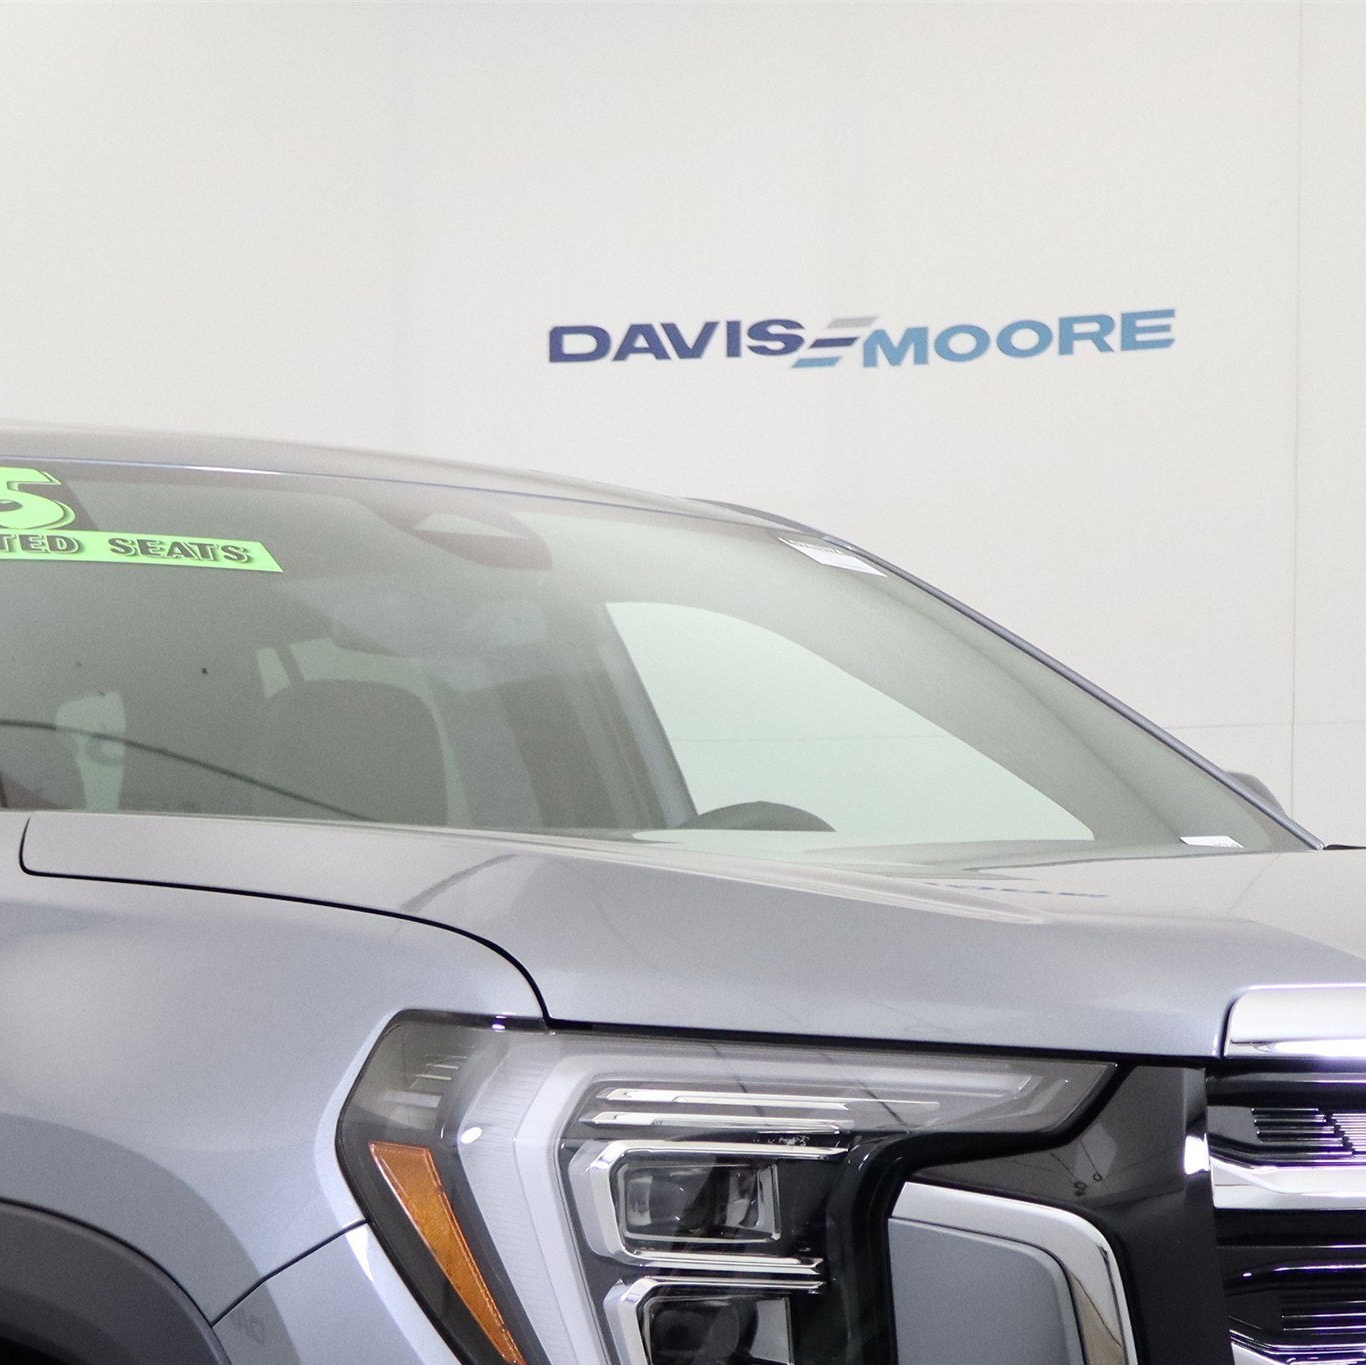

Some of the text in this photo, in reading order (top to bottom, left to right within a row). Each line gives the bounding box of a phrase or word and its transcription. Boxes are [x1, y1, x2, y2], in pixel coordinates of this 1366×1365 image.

[548, 308, 1176, 368] DAVIS MOORE
[108, 537, 253, 563] SEATS
